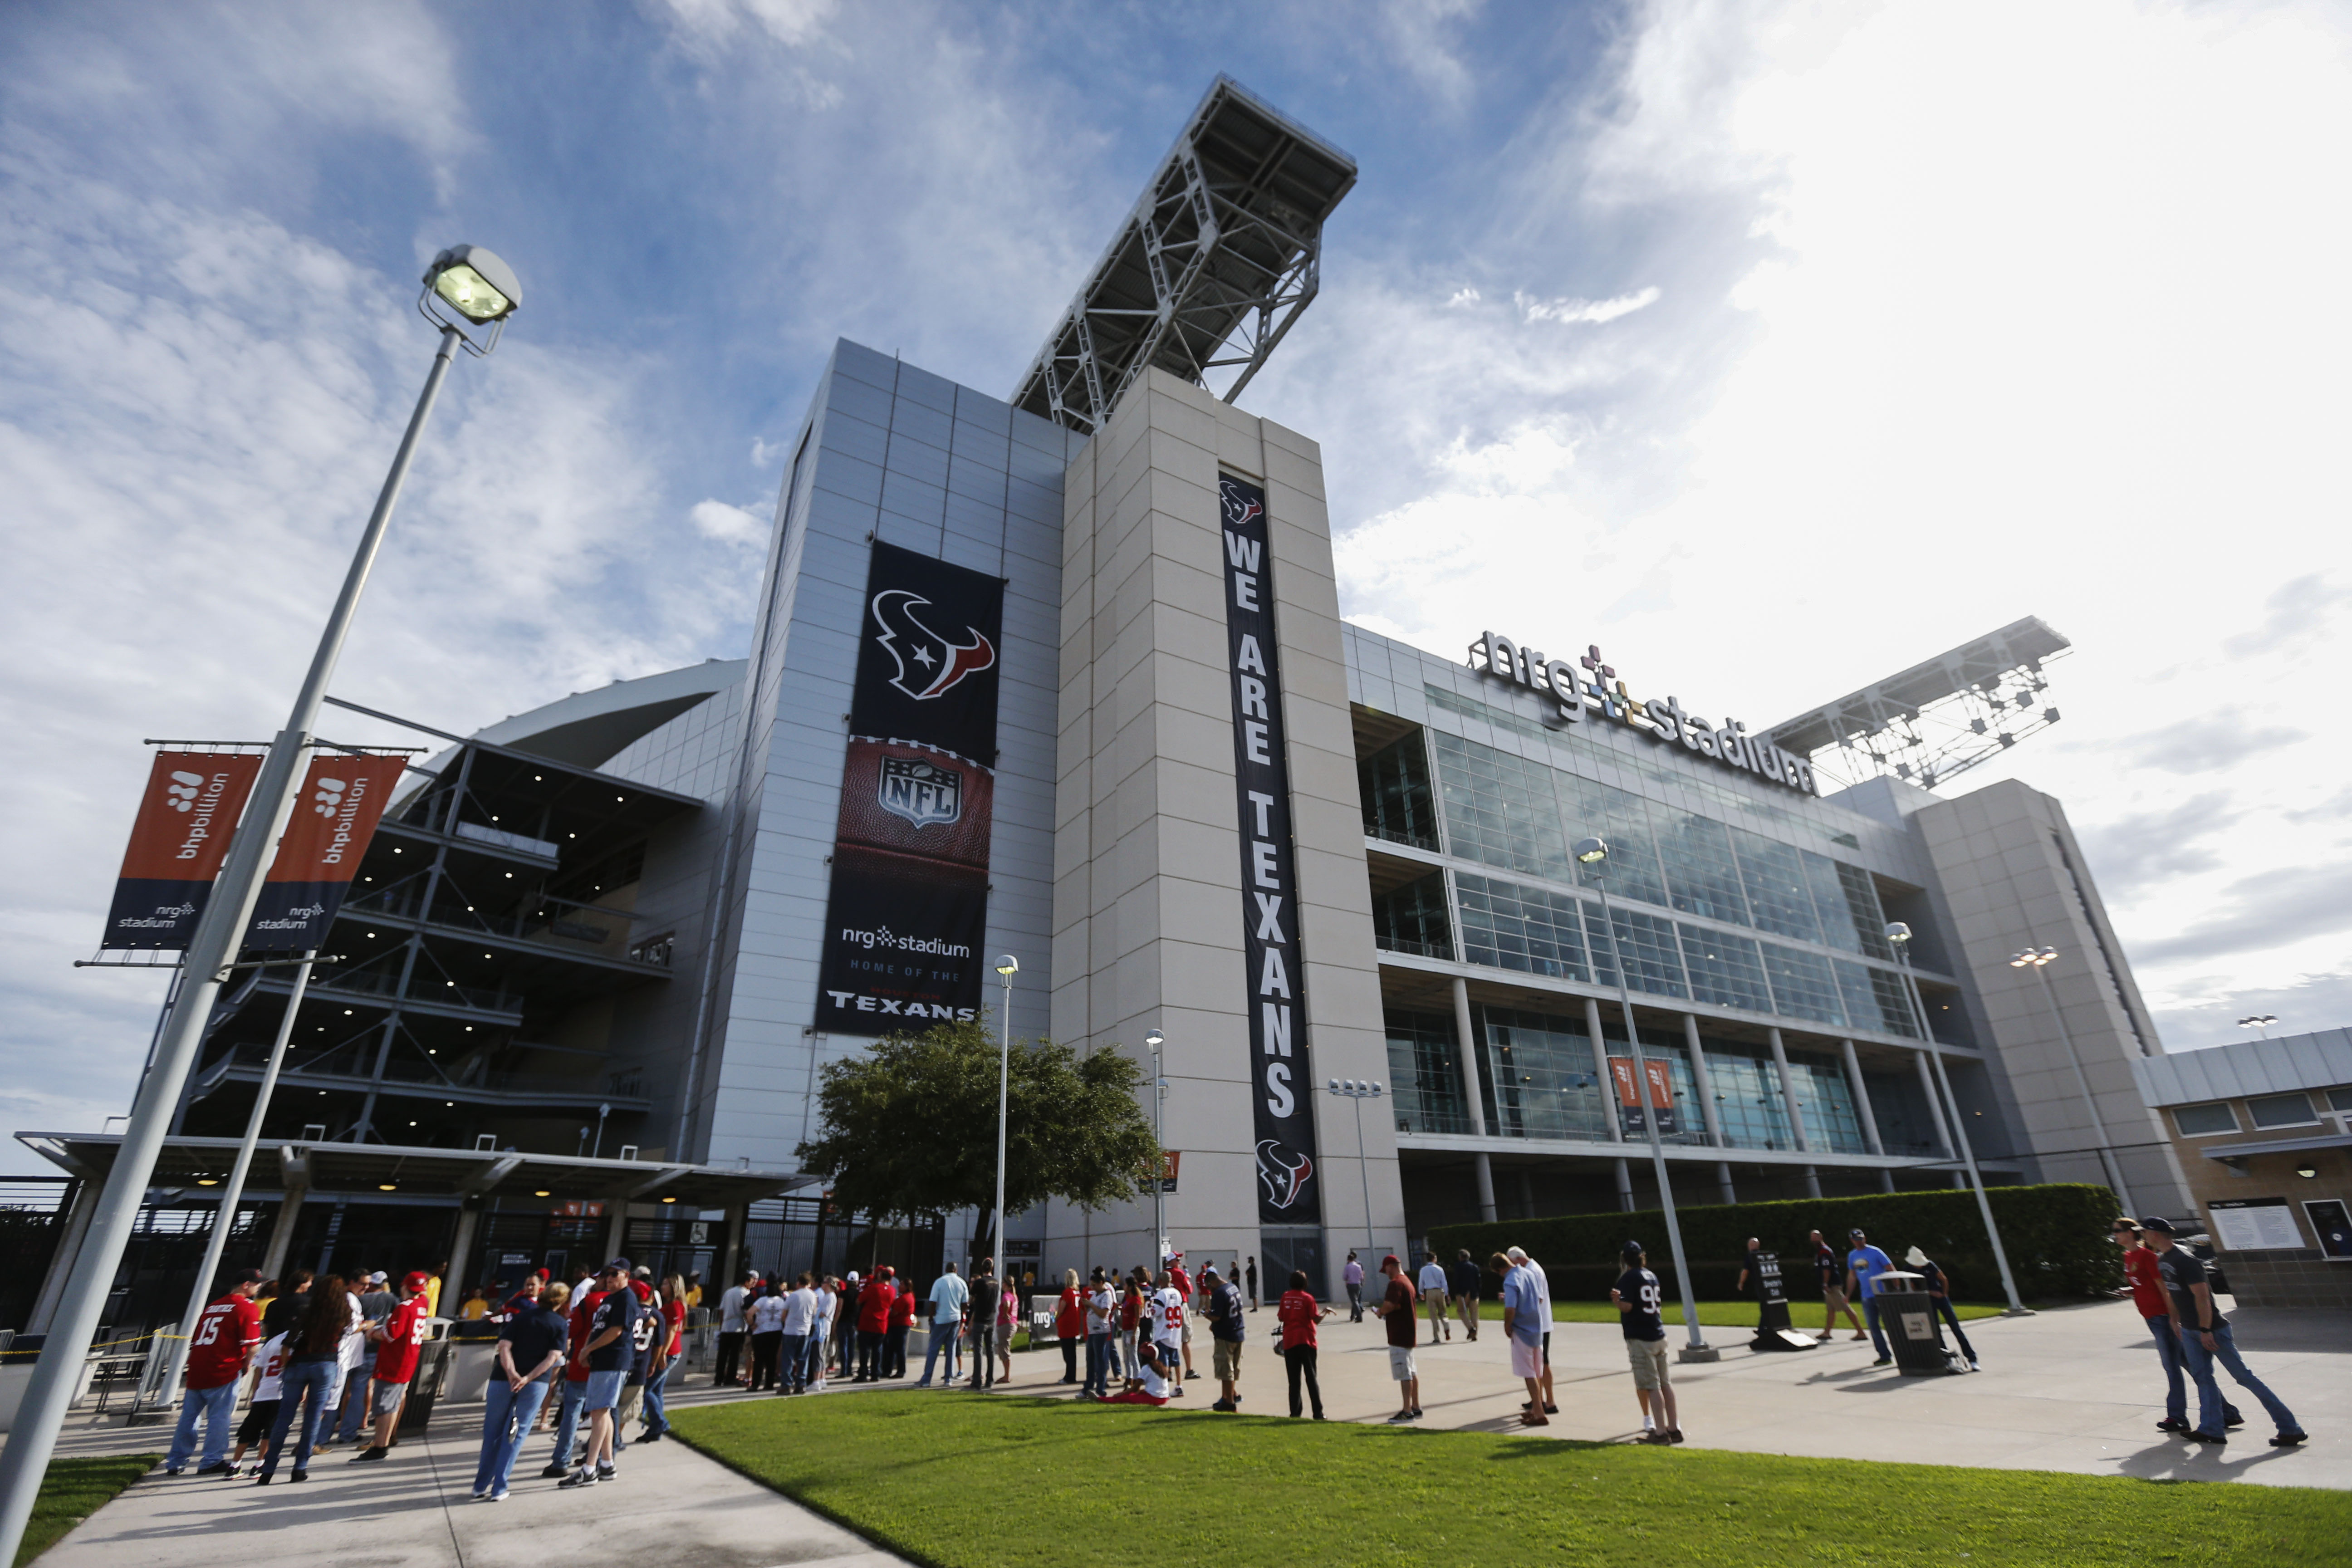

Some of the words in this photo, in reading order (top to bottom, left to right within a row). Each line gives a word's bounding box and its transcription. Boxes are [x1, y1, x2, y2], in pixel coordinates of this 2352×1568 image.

[1225, 529, 1261, 612] WE
[1238, 633, 1269, 765] ARE
[1483, 631, 1587, 723] nrg
[1645, 696, 1821, 798] stadium
[888, 776, 951, 816] NFL
[176, 773, 230, 859] bhpbilliton
[321, 777, 368, 864] bhpbilliton
[118, 917, 176, 928] stadium
[155, 906, 182, 918] nrg
[256, 919, 307, 930] stadium
[289, 906, 311, 919] nrg
[842, 928, 874, 949] nrg
[898, 936, 970, 958] stadium
[1249, 790, 1294, 1118] TEXANS
[851, 959, 894, 974] HOME
[904, 967, 922, 977] OF
[931, 971, 959, 982] THE
[826, 990, 975, 1021] TEXANS
[869, 986, 941, 1000] HOUSTON
[195, 1316, 224, 1345] 15
[1034, 1311, 1051, 1328] nrg
[1165, 1306, 1183, 1329] 99
